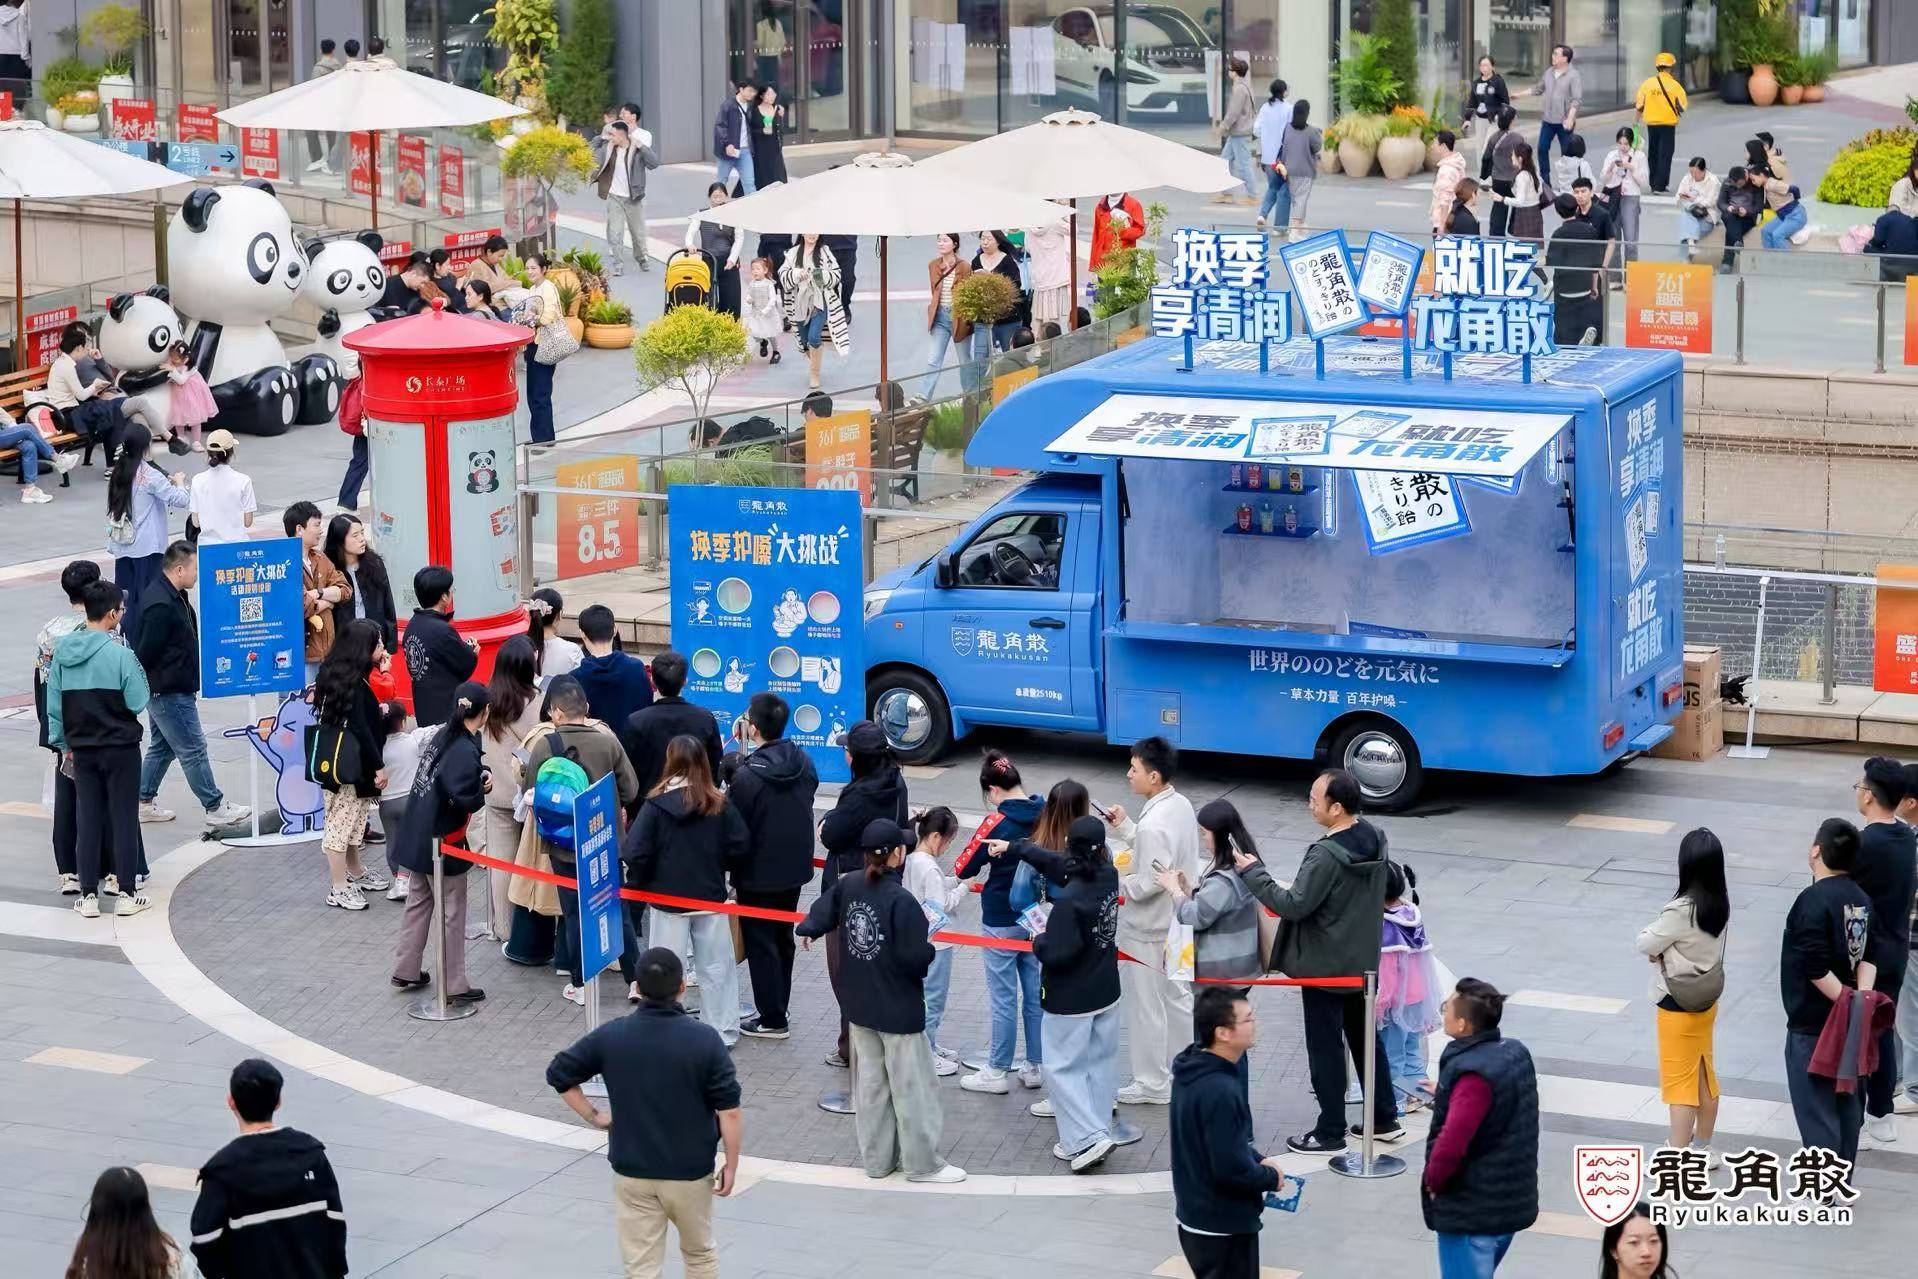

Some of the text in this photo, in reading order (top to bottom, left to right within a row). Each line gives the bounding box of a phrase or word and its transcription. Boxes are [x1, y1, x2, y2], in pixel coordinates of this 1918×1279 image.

[1172, 228, 1269, 287] 换季
[1320, 252, 1354, 315] 龍角散の
[1433, 237, 1538, 298] 就吃
[1151, 286, 1292, 344] 享清润
[1411, 295, 1555, 355] 龙角散
[1086, 426, 1249, 449] 享清润
[1130, 412, 1240, 431] 换季
[1395, 424, 1514, 445] 就吃
[1627, 397, 1657, 451] 换季
[1347, 439, 1514, 463] 龙角散
[1619, 437, 1664, 499] 享清润
[1627, 579, 1657, 632] 就吃
[977, 629, 1049, 653] 龍角散
[978, 650, 1048, 662] Ryukakusan
[1248, 649, 1440, 685] 世界ののどを元気に
[1620, 616, 1664, 680] 龙角散
[1290, 687, 1396, 707] 草本力量 百年护嗓
